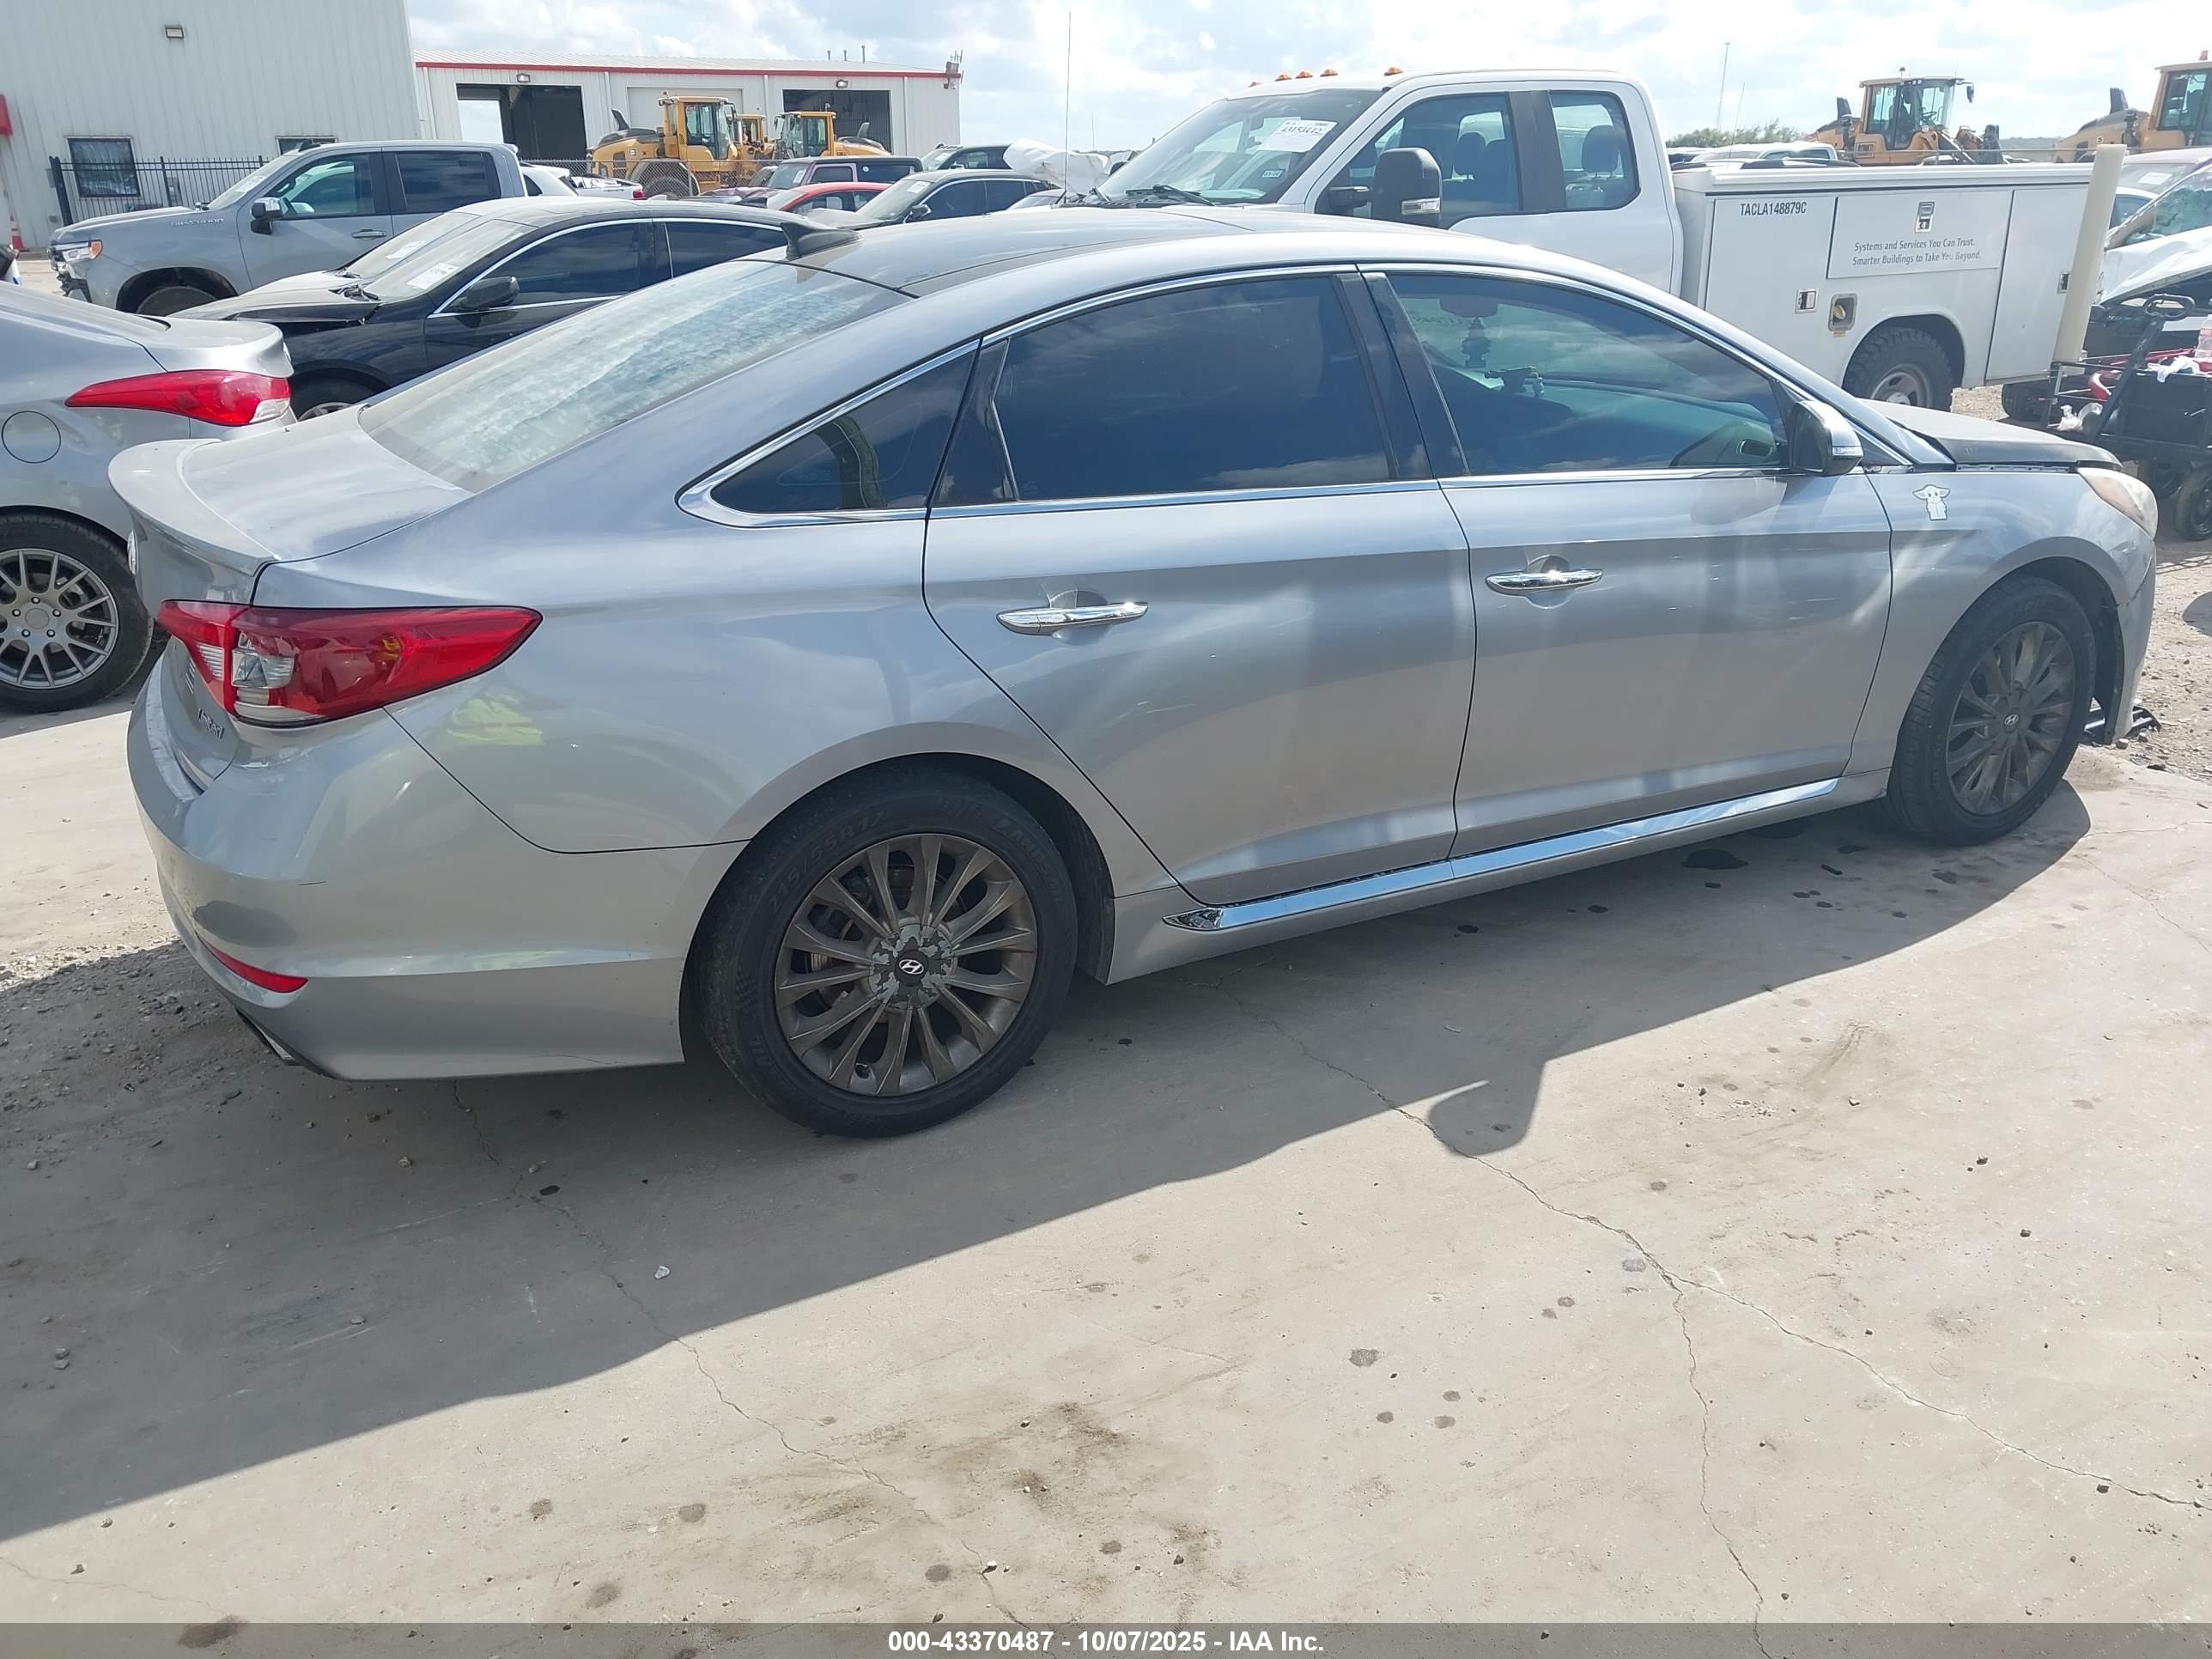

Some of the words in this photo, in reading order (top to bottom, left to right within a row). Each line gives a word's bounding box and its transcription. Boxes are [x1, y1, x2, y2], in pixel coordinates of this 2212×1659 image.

[1740, 201, 1808, 216] TACLA148879C
[1854, 241, 1883, 254] Systems
[1884, 240, 1898, 250] and
[1899, 240, 1927, 249] Services
[1929, 239, 1942, 248] You
[1942, 238, 1955, 247] Can
[1852, 256, 1881, 265] Smarter
[1881, 253, 1914, 265] Buildings
[1924, 252, 1940, 262] Take
[1942, 252, 1954, 261] You
